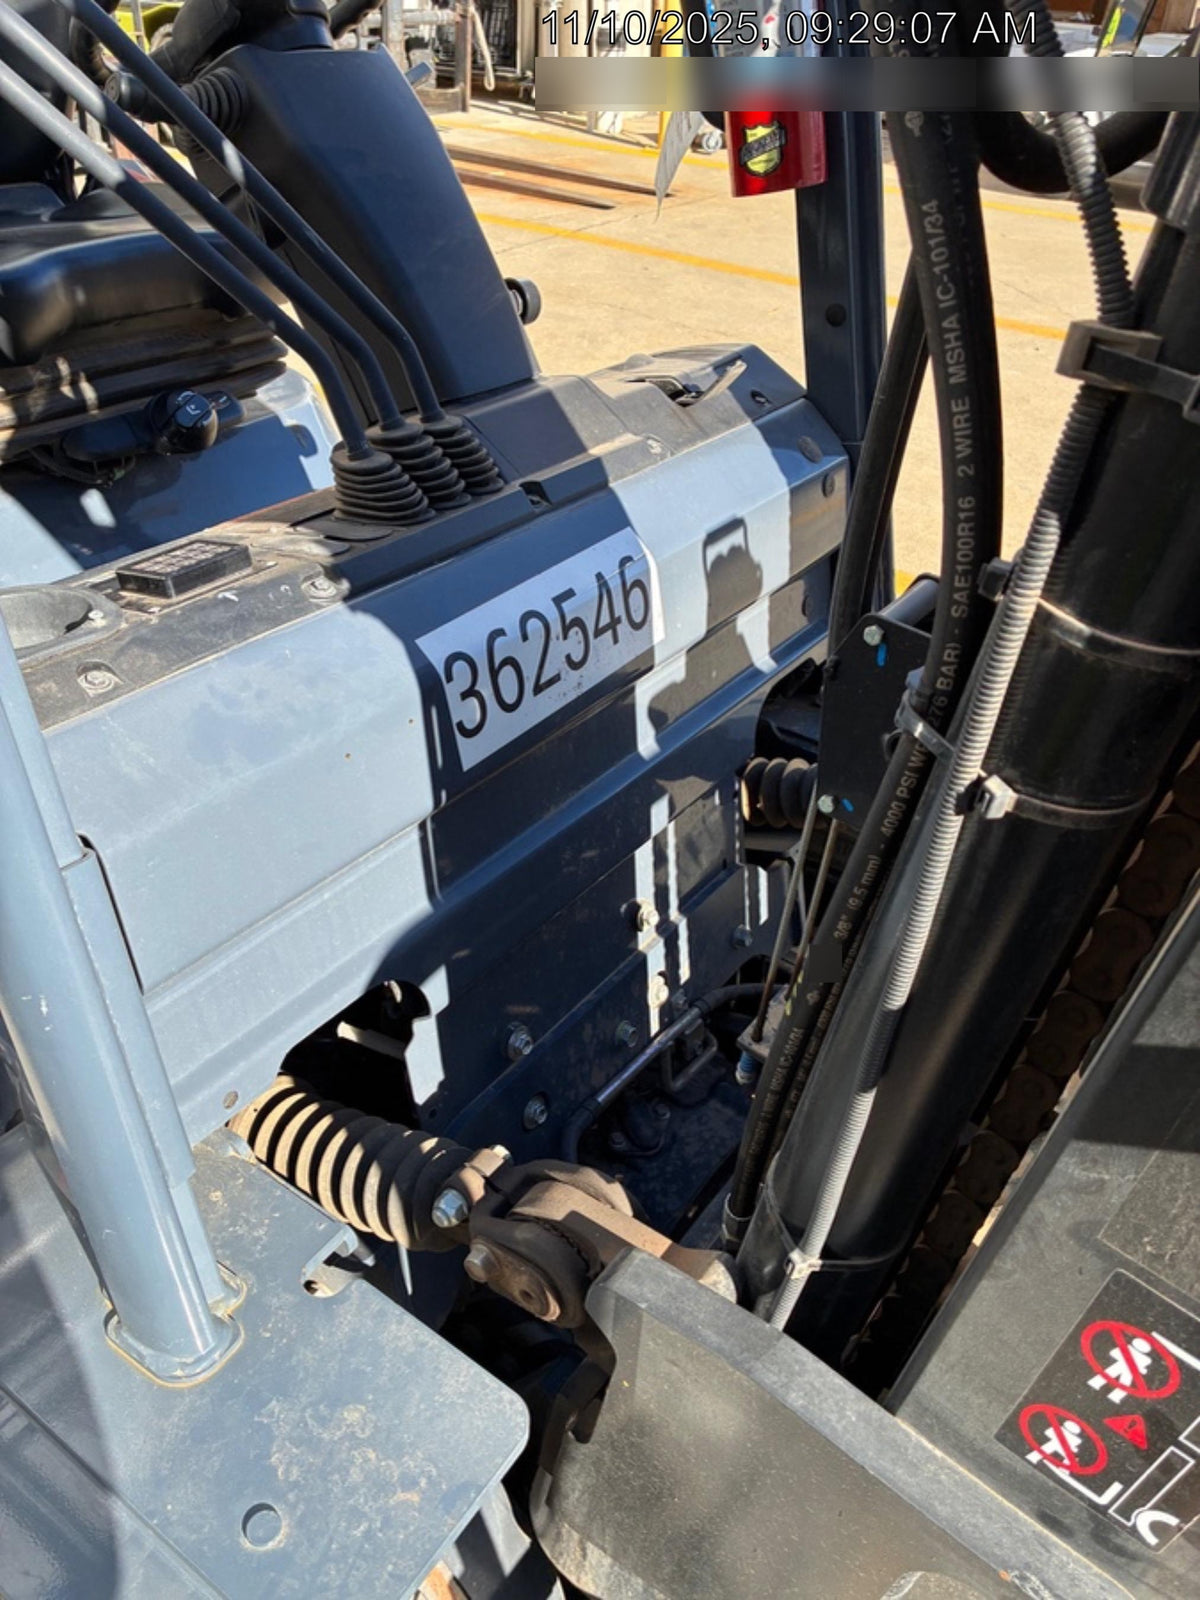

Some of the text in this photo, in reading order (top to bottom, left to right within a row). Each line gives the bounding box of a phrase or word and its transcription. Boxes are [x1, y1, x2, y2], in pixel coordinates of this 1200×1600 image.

[921, 200, 957, 308] IC-101/34
[942, 313, 967, 385] MSHA
[952, 396, 974, 459] WIRE
[957, 463, 975, 477] 2
[951, 495, 976, 619] SAE100R16
[444, 555, 650, 739] 362546
[896, 766, 921, 800] PSI
[880, 803, 905, 838] 4000
